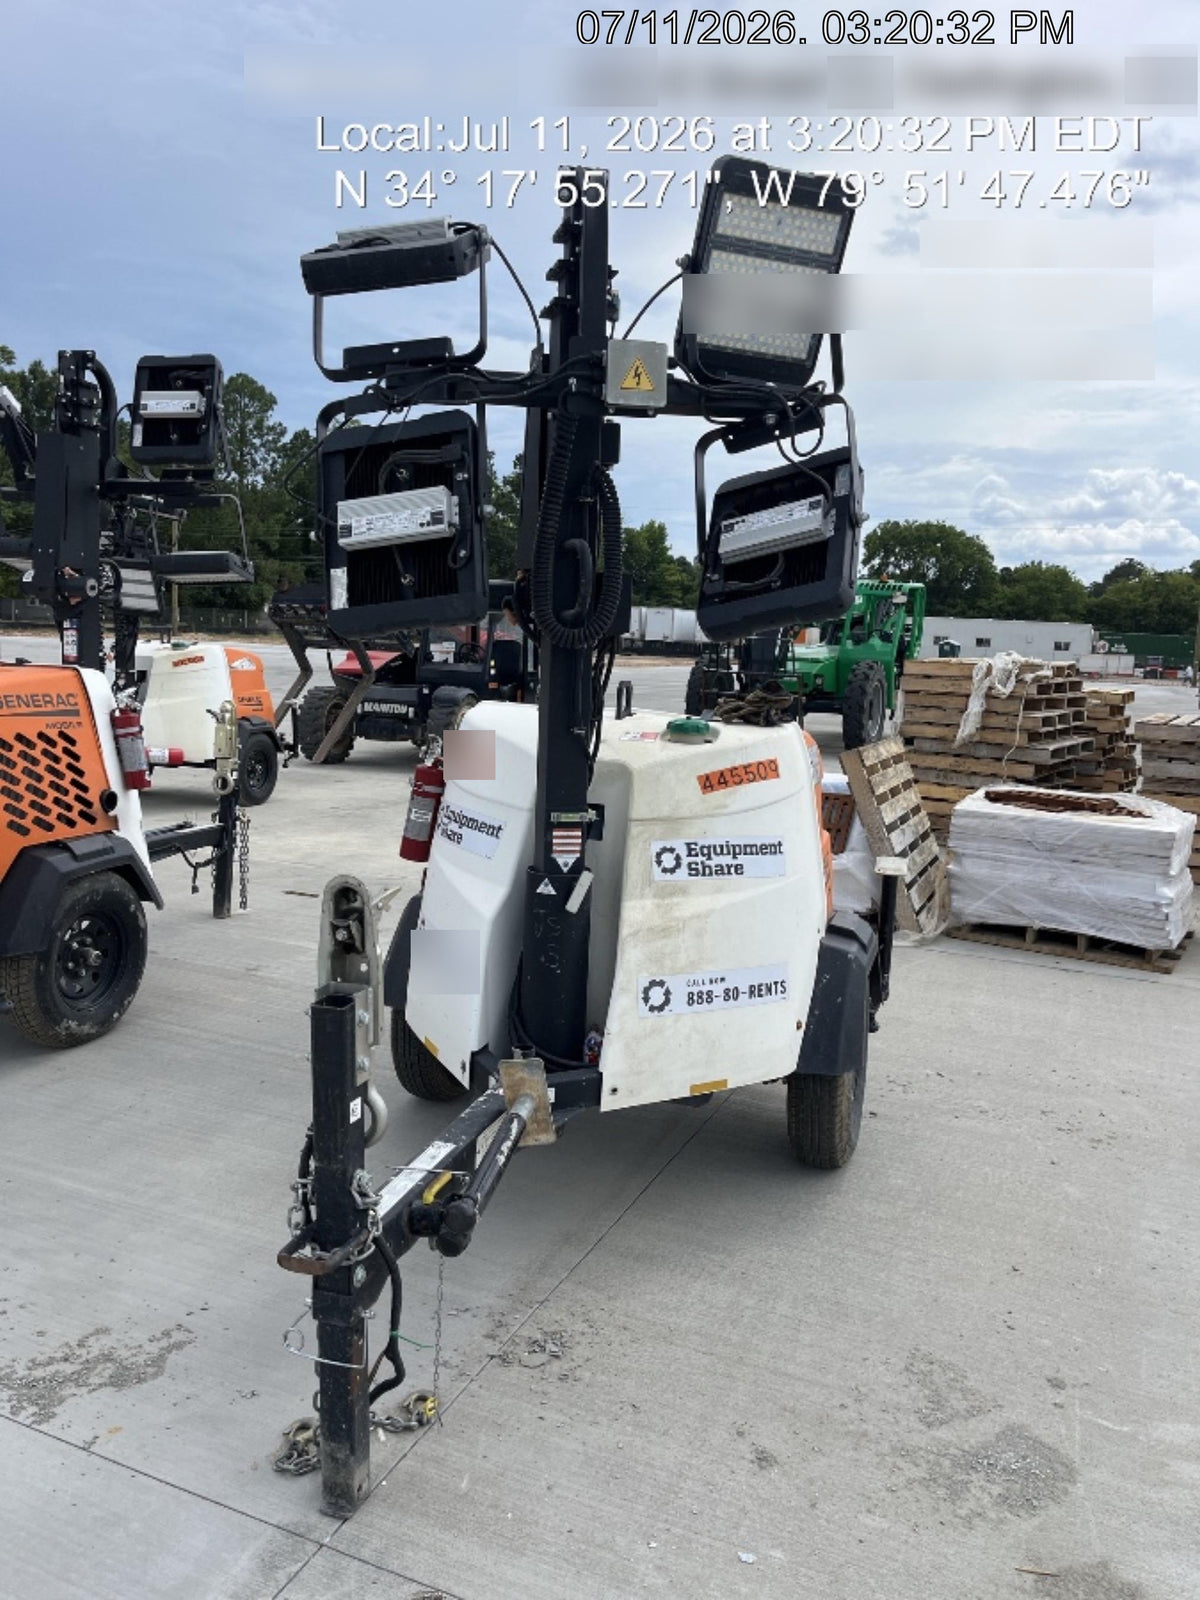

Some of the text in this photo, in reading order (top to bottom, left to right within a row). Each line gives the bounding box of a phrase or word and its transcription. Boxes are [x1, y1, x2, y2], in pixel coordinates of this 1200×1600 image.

[703, 760, 779, 792] 445509
[684, 840, 783, 861] Equipment
[686, 860, 745, 877] Share
[686, 979, 787, 1007] 888-80-RENTS
